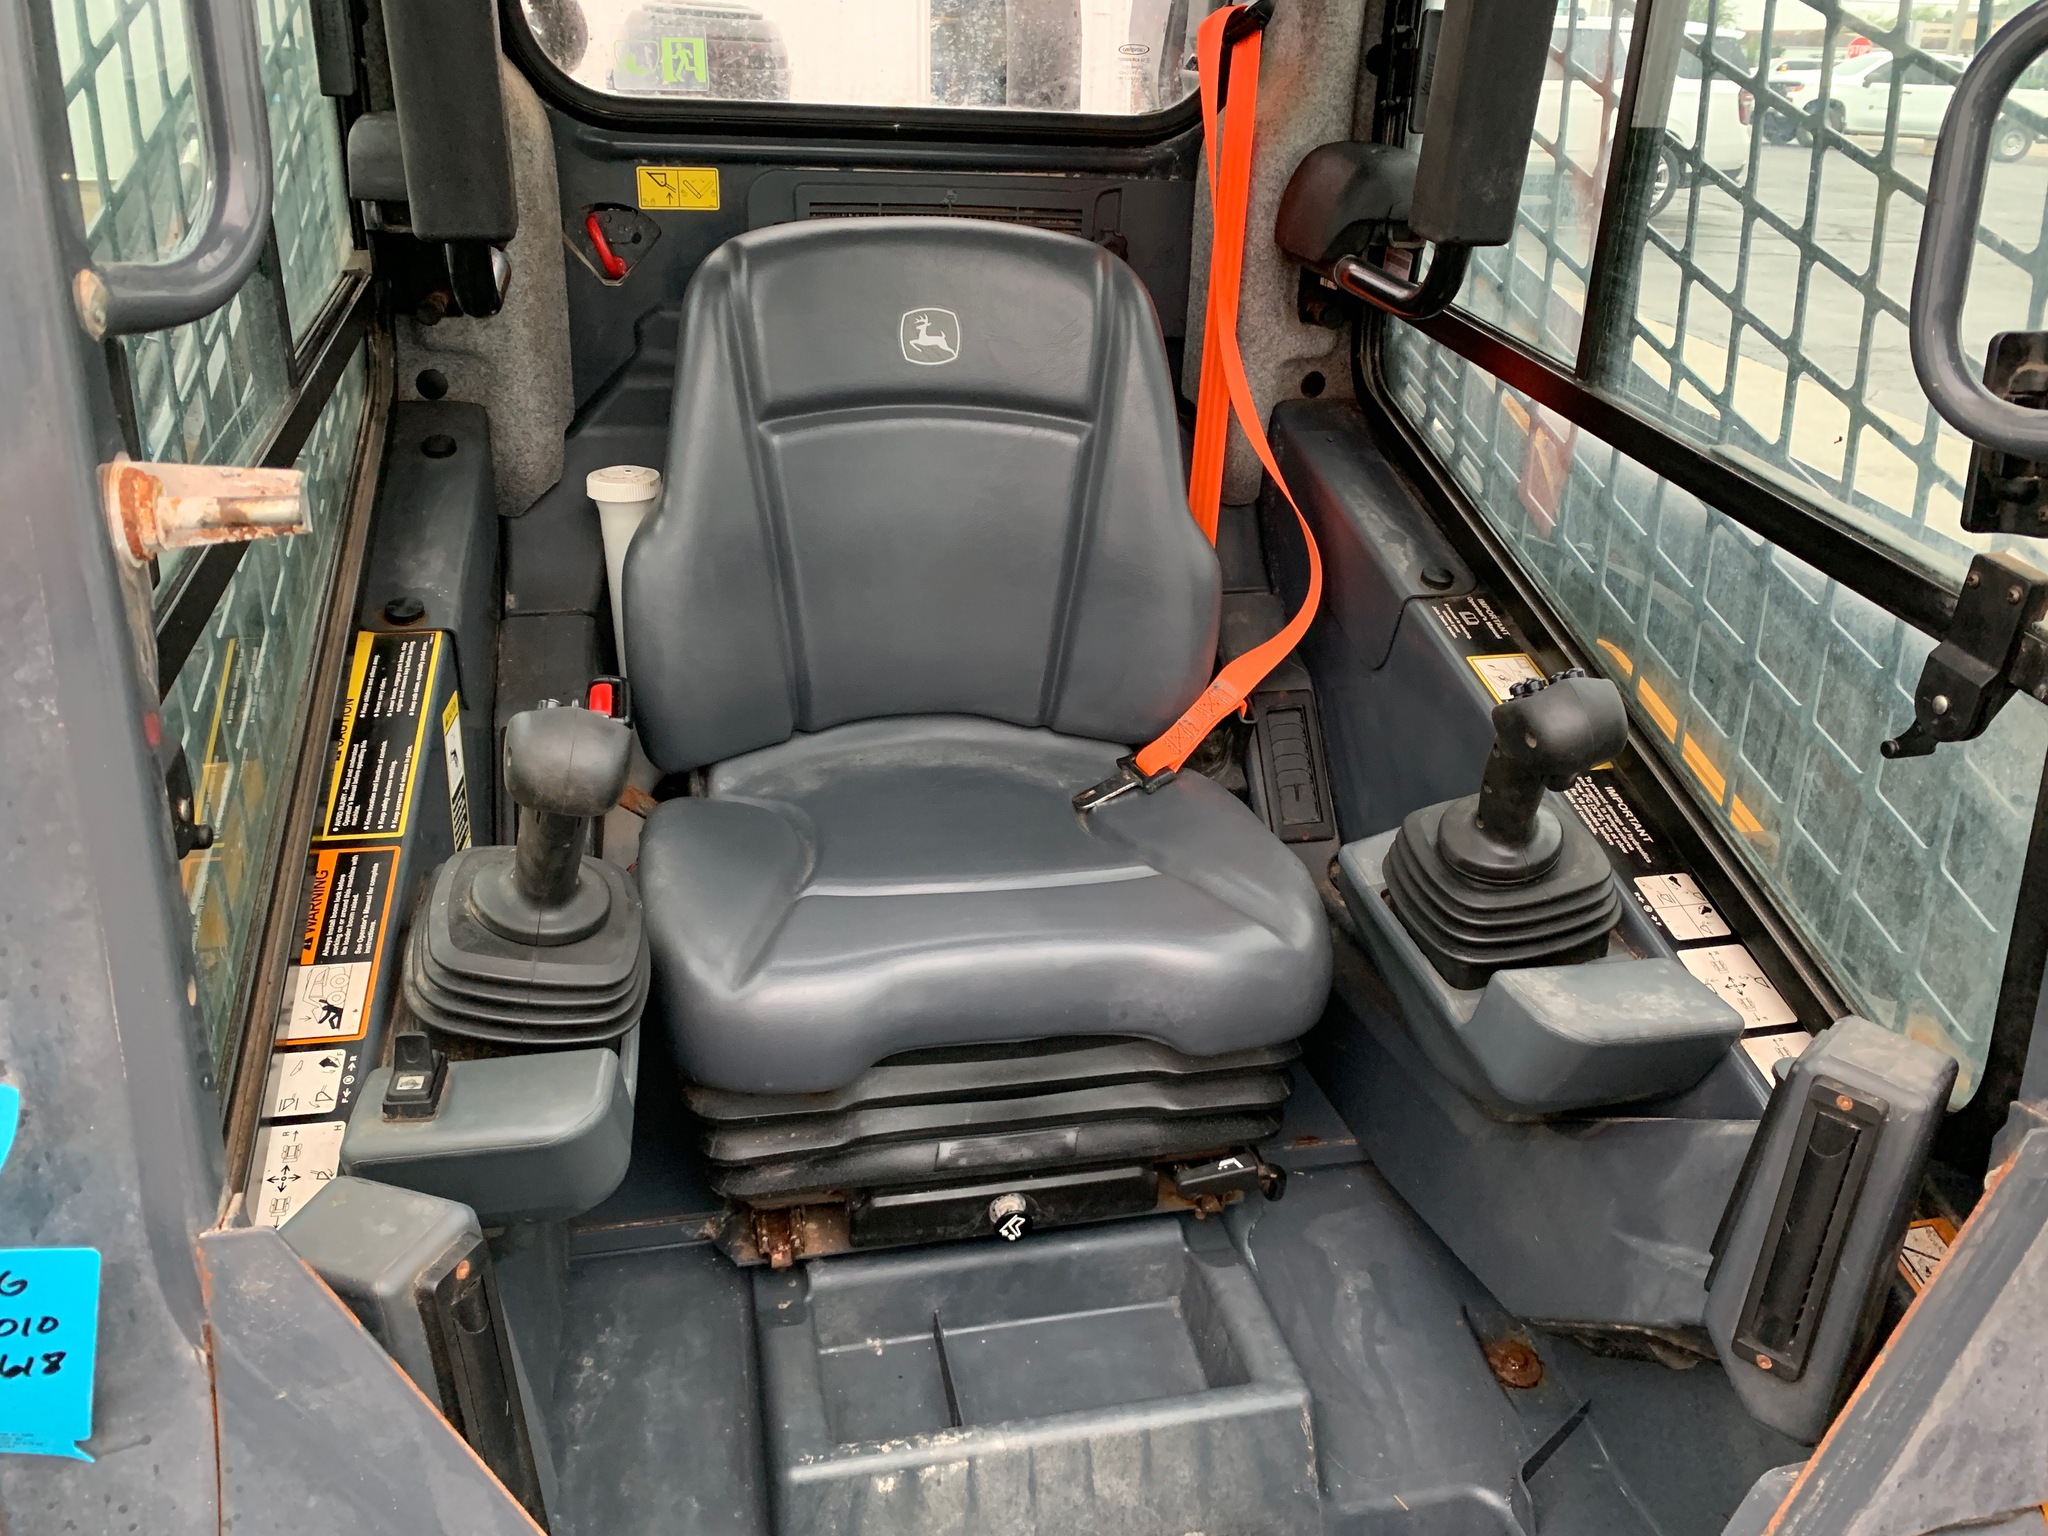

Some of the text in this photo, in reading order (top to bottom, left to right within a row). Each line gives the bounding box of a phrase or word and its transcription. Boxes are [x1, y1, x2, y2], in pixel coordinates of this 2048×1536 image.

[1467, 596, 1502, 639] Operator's Manual
[1477, 599, 1511, 636] IMPORTANT
[387, 700, 395, 712] Lower
[394, 672, 402, 686] engage
[396, 698, 404, 712] engine
[404, 655, 412, 667] before
[363, 686, 372, 702] children
[360, 703, 369, 713] Keep
[374, 701, 382, 713] Never
[409, 700, 417, 711] Keep
[349, 744, 359, 768] understand
[356, 749, 367, 769] operating
[352, 770, 361, 784] before
[373, 764, 382, 783] function
[343, 778, 351, 790] Read
[348, 785, 357, 801] Manual
[384, 779, 393, 797] devices
[338, 793, 347, 810] INJURY
[367, 792, 376, 811] location
[392, 811, 401, 824] Keep
[400, 763, 409, 783] windows
[381, 797, 390, 811] safety
[334, 811, 343, 826] AVOID
[342, 802, 354, 826] Operator's
[364, 811, 373, 825] Know
[378, 812, 387, 824] Keep
[1588, 783, 1609, 804] prevent
[1605, 804, 1624, 826] damage
[1627, 833, 1652, 863] hydraulics
[1604, 786, 1654, 842] IMPORTANT
[1581, 804, 1600, 826] minutes
[1598, 827, 1614, 845] before
[1605, 814, 1634, 851] temperatures
[1615, 840, 1629, 854] slow
[351, 855, 359, 866] with
[336, 874, 346, 890] before
[347, 866, 356, 888] machine
[370, 863, 379, 886] complete
[306, 870, 328, 934] WARNING
[334, 891, 342, 902] lock
[344, 888, 352, 898] this
[330, 903, 339, 918] boom
[340, 899, 349, 918] around
[363, 895, 372, 914] Manual
[346, 912, 355, 927] boom
[342, 928, 352, 945] loader
[357, 915, 369, 943] Operator's
[322, 936, 333, 956] Always
[332, 934, 343, 956] working
[340, 946, 348, 955] the
[354, 944, 363, 954] See
